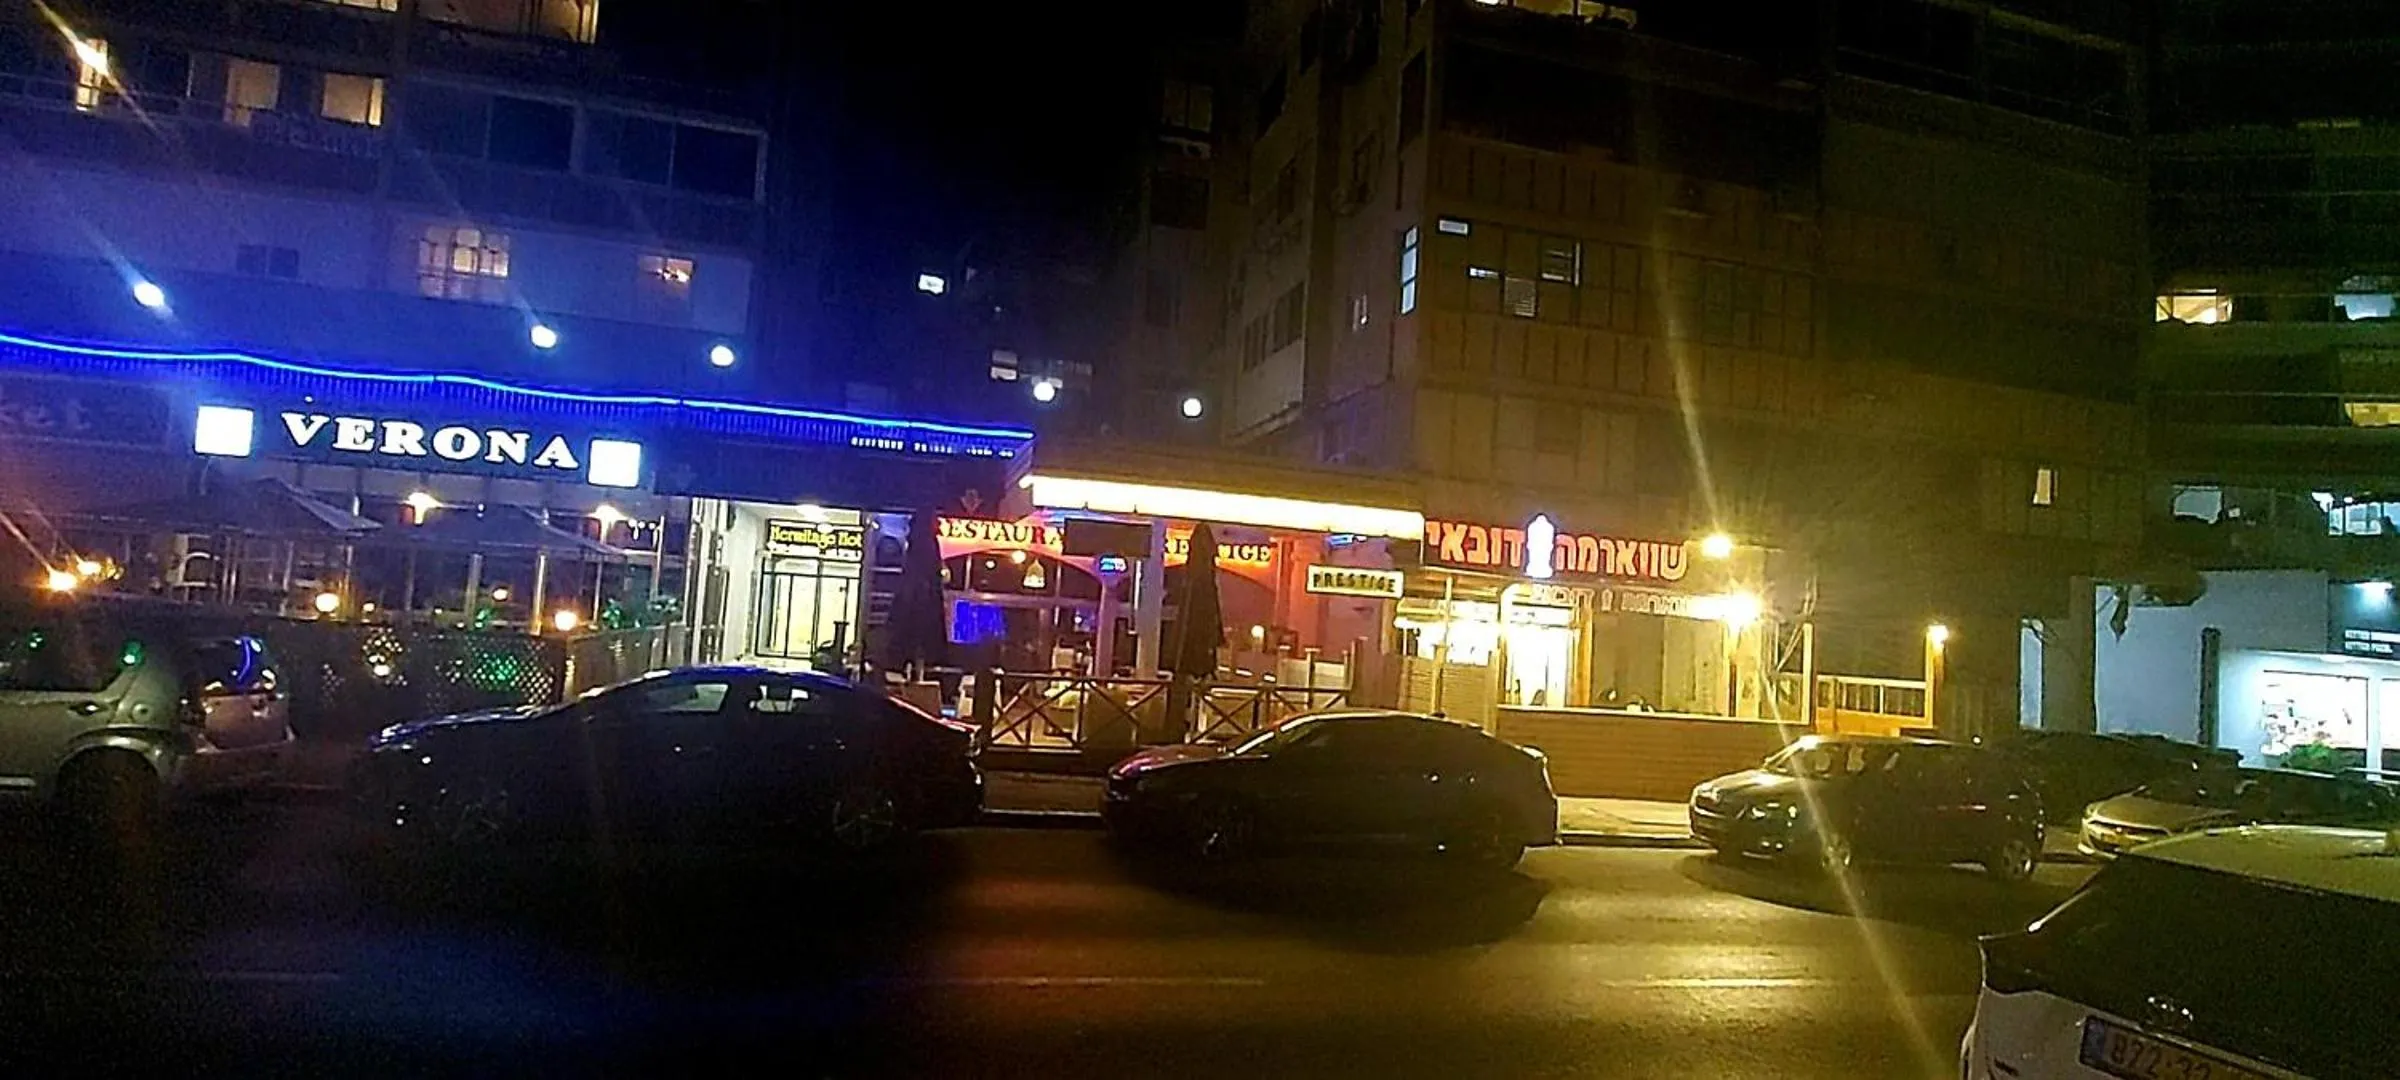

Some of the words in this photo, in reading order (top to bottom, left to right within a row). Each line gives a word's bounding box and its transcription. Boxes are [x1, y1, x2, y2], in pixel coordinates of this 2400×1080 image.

[280, 411, 578, 470] VERONA
[1425, 520, 1526, 568] דובאי
[1556, 533, 1689, 581] שווארמה
[1312, 569, 1397, 594] PRESTIGE
